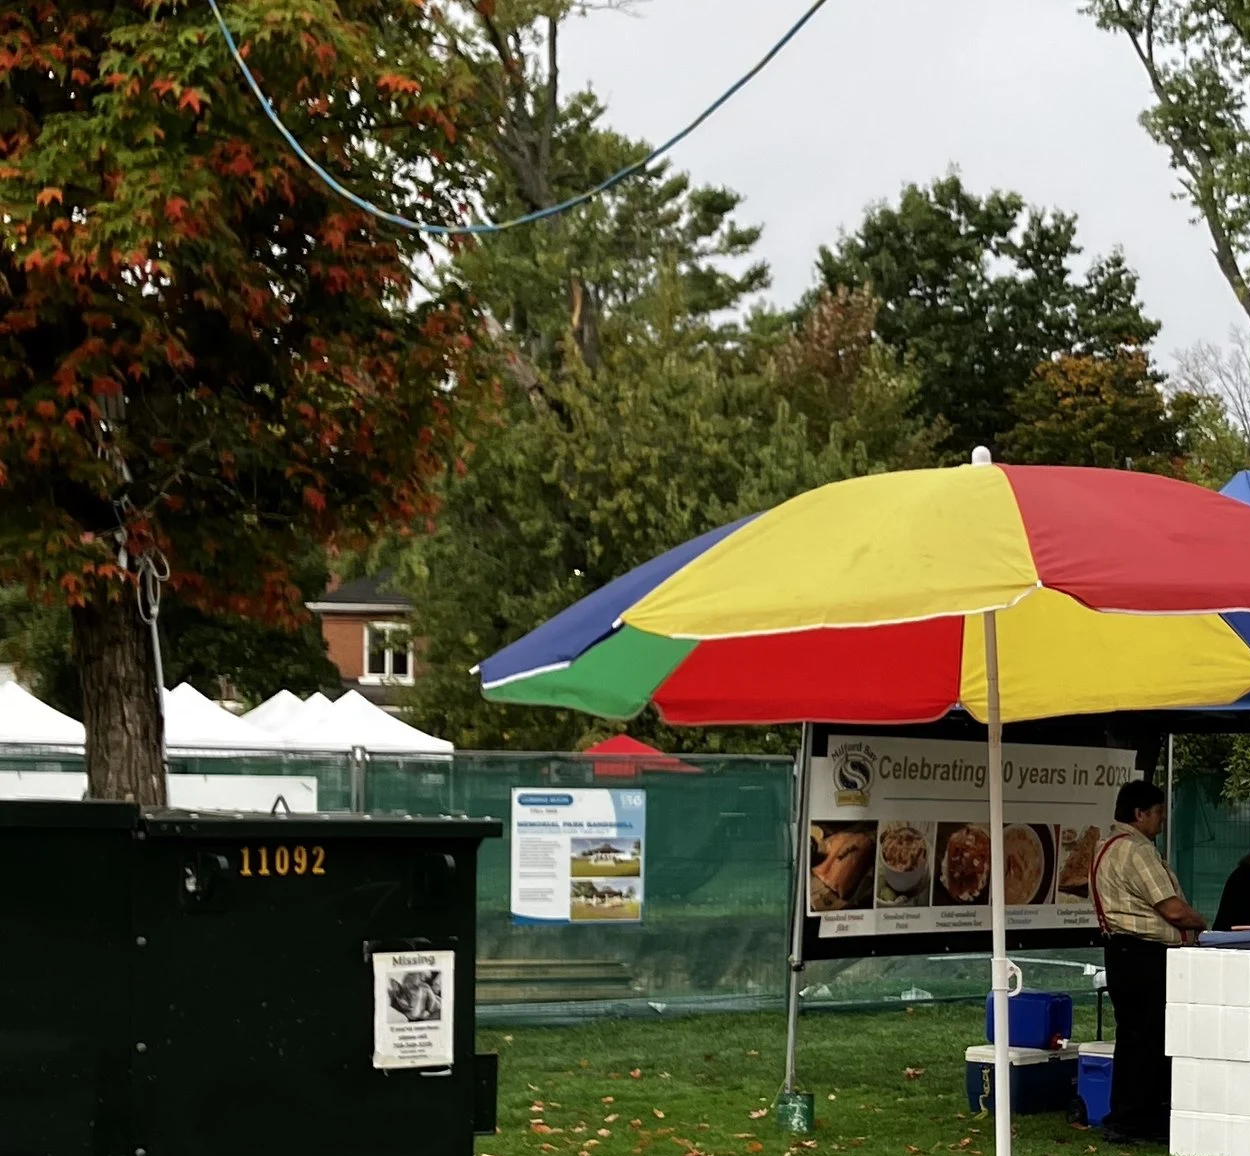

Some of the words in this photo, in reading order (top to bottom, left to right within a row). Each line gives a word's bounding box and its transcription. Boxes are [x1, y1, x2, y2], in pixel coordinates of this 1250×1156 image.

[831, 741, 862, 761] Milford
[863, 744, 878, 762] Bay
[878, 754, 987, 789] Celebrating
[1018, 763, 1067, 789] years
[1072, 763, 1088, 785] in
[240, 846, 326, 876] 11092
[392, 954, 436, 967] Missing
